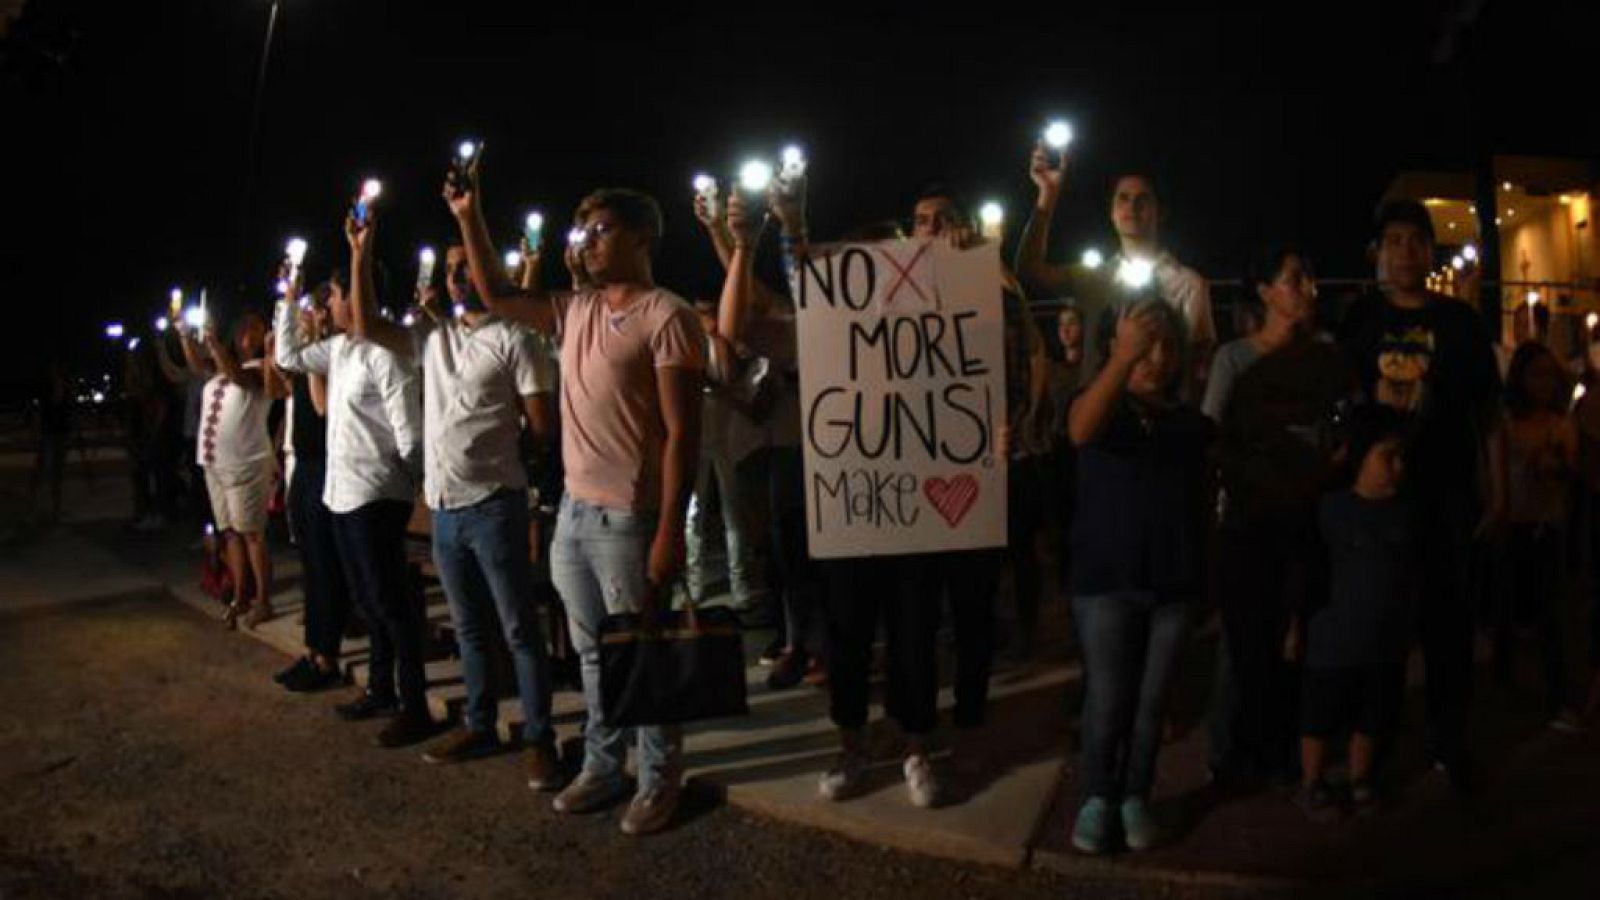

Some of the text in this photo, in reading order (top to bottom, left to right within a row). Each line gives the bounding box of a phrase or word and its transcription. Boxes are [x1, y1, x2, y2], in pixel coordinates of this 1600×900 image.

[800, 247, 876, 310] NO
[849, 312, 990, 381] MORE
[808, 383, 994, 469] GUNS!
[813, 469, 921, 532] Make
